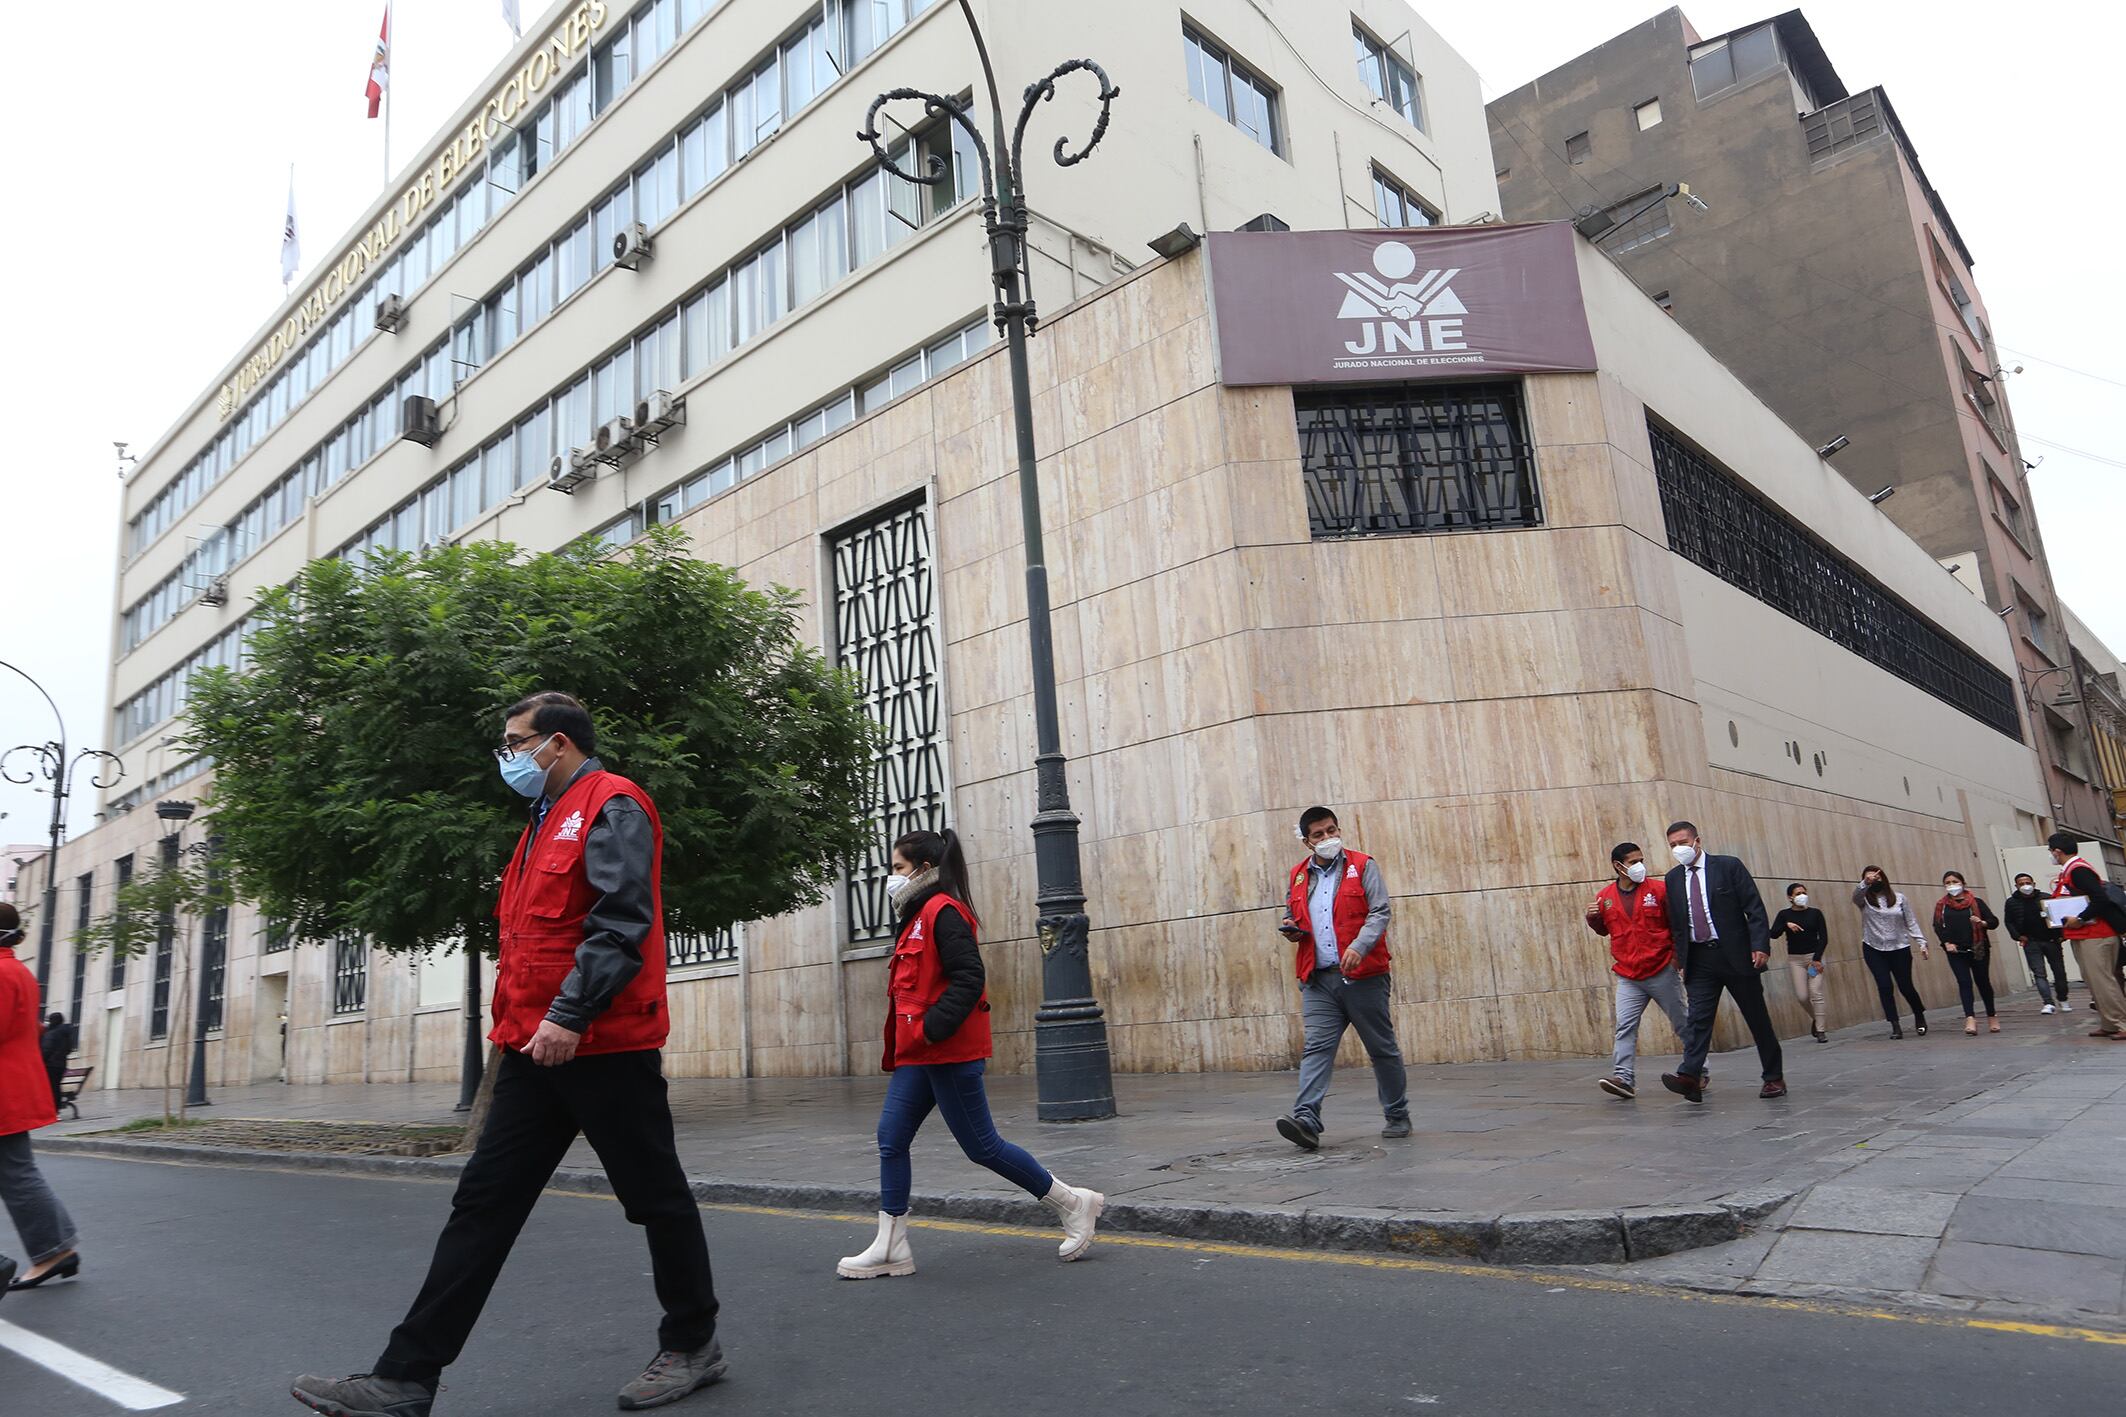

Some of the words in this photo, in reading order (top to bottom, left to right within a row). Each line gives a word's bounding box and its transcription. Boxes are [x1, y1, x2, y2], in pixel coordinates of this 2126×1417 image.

[232, 317, 297, 409] JURADO
[299, 207, 400, 335] NACIONAL
[403, 167, 434, 227] DE
[440, 0, 608, 190] ELECCIONES
[1344, 318, 1468, 355] JNE
[1333, 360, 1369, 369] JURADO
[1370, 358, 1415, 368] NACIONAL
[1417, 358, 1429, 366] DE
[1430, 355, 1485, 365] ELECCIONES
[558, 828, 579, 836] JNE
